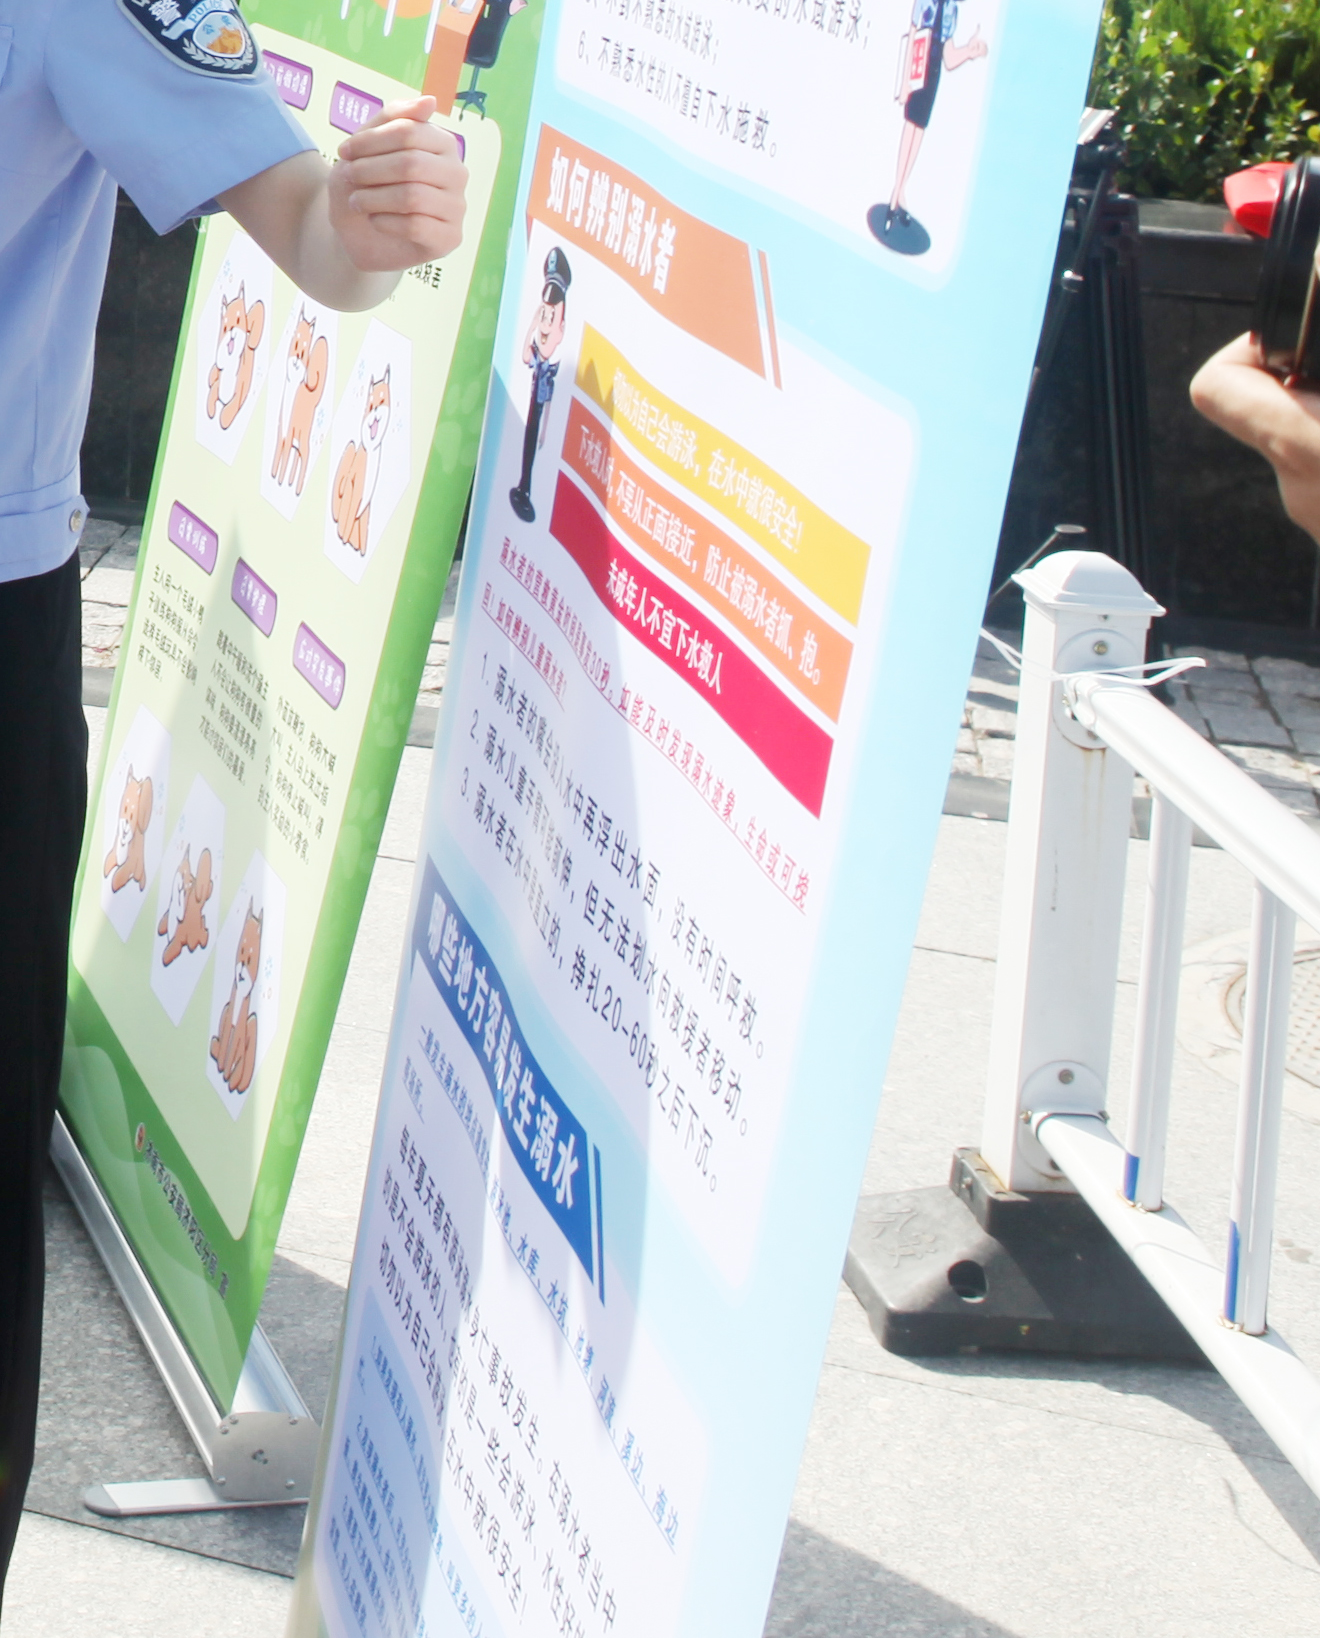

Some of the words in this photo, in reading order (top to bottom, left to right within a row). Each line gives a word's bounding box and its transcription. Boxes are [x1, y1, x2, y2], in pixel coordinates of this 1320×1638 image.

[546, 146, 678, 296] 如何辨别溺水者
[606, 557, 722, 696] 未成年人不宜下水救人
[426, 891, 579, 1212] 哪些地方容易发生溺水
